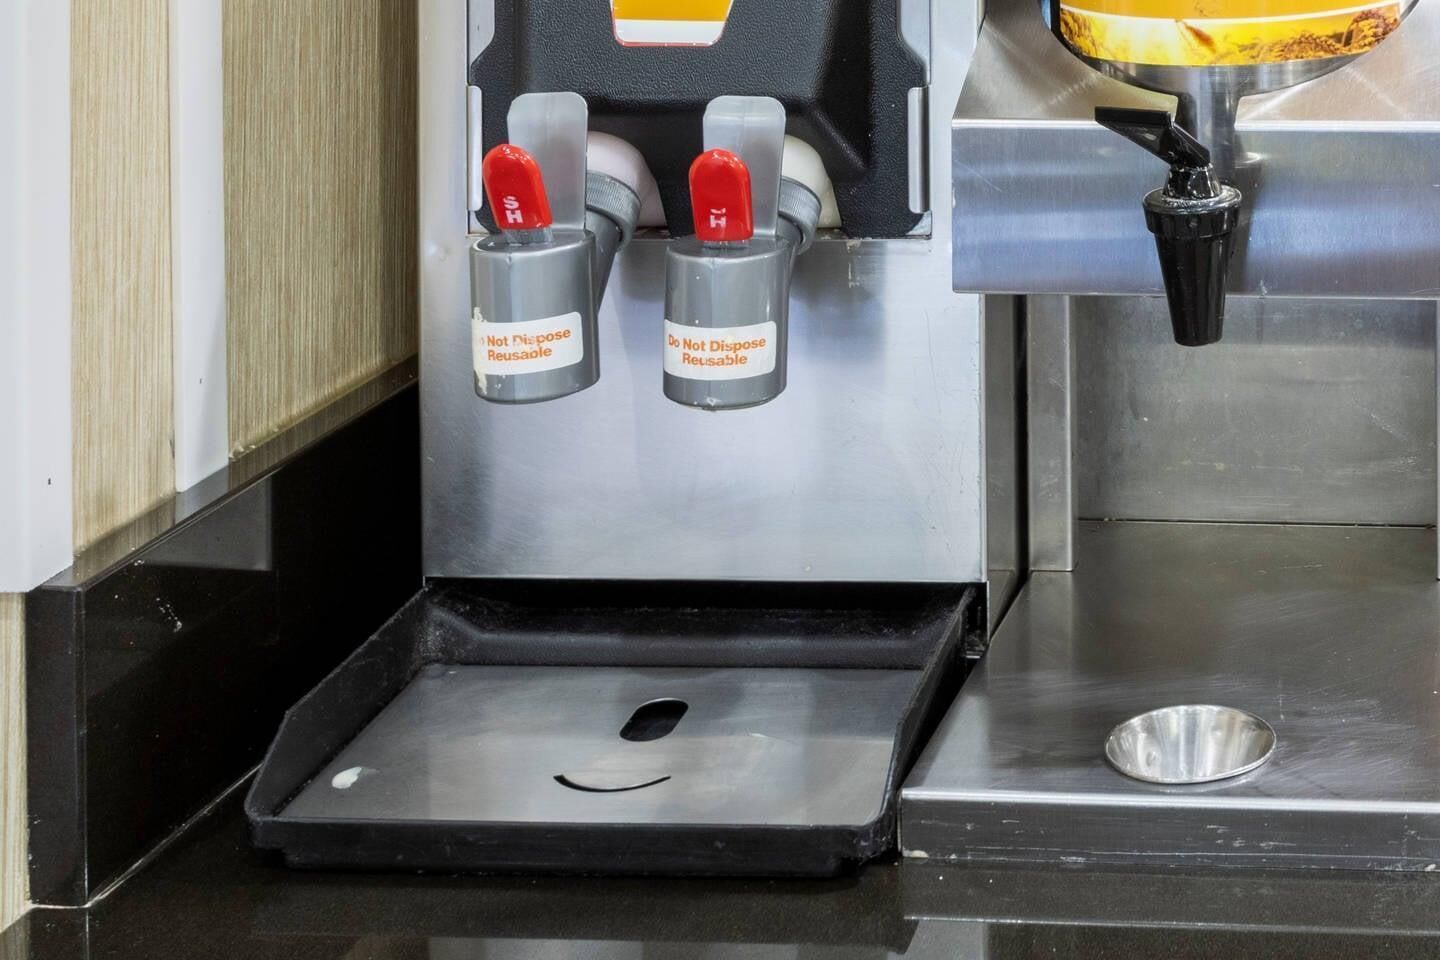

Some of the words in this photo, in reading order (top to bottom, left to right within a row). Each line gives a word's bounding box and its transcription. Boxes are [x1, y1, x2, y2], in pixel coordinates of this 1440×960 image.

[487, 335, 508, 347] Not
[512, 329, 571, 346] Dispose
[668, 334, 680, 348] Do
[683, 338, 706, 352] Not
[710, 338, 766, 354] Dispose
[487, 346, 552, 361] Reusable
[682, 353, 748, 367] Reusable
